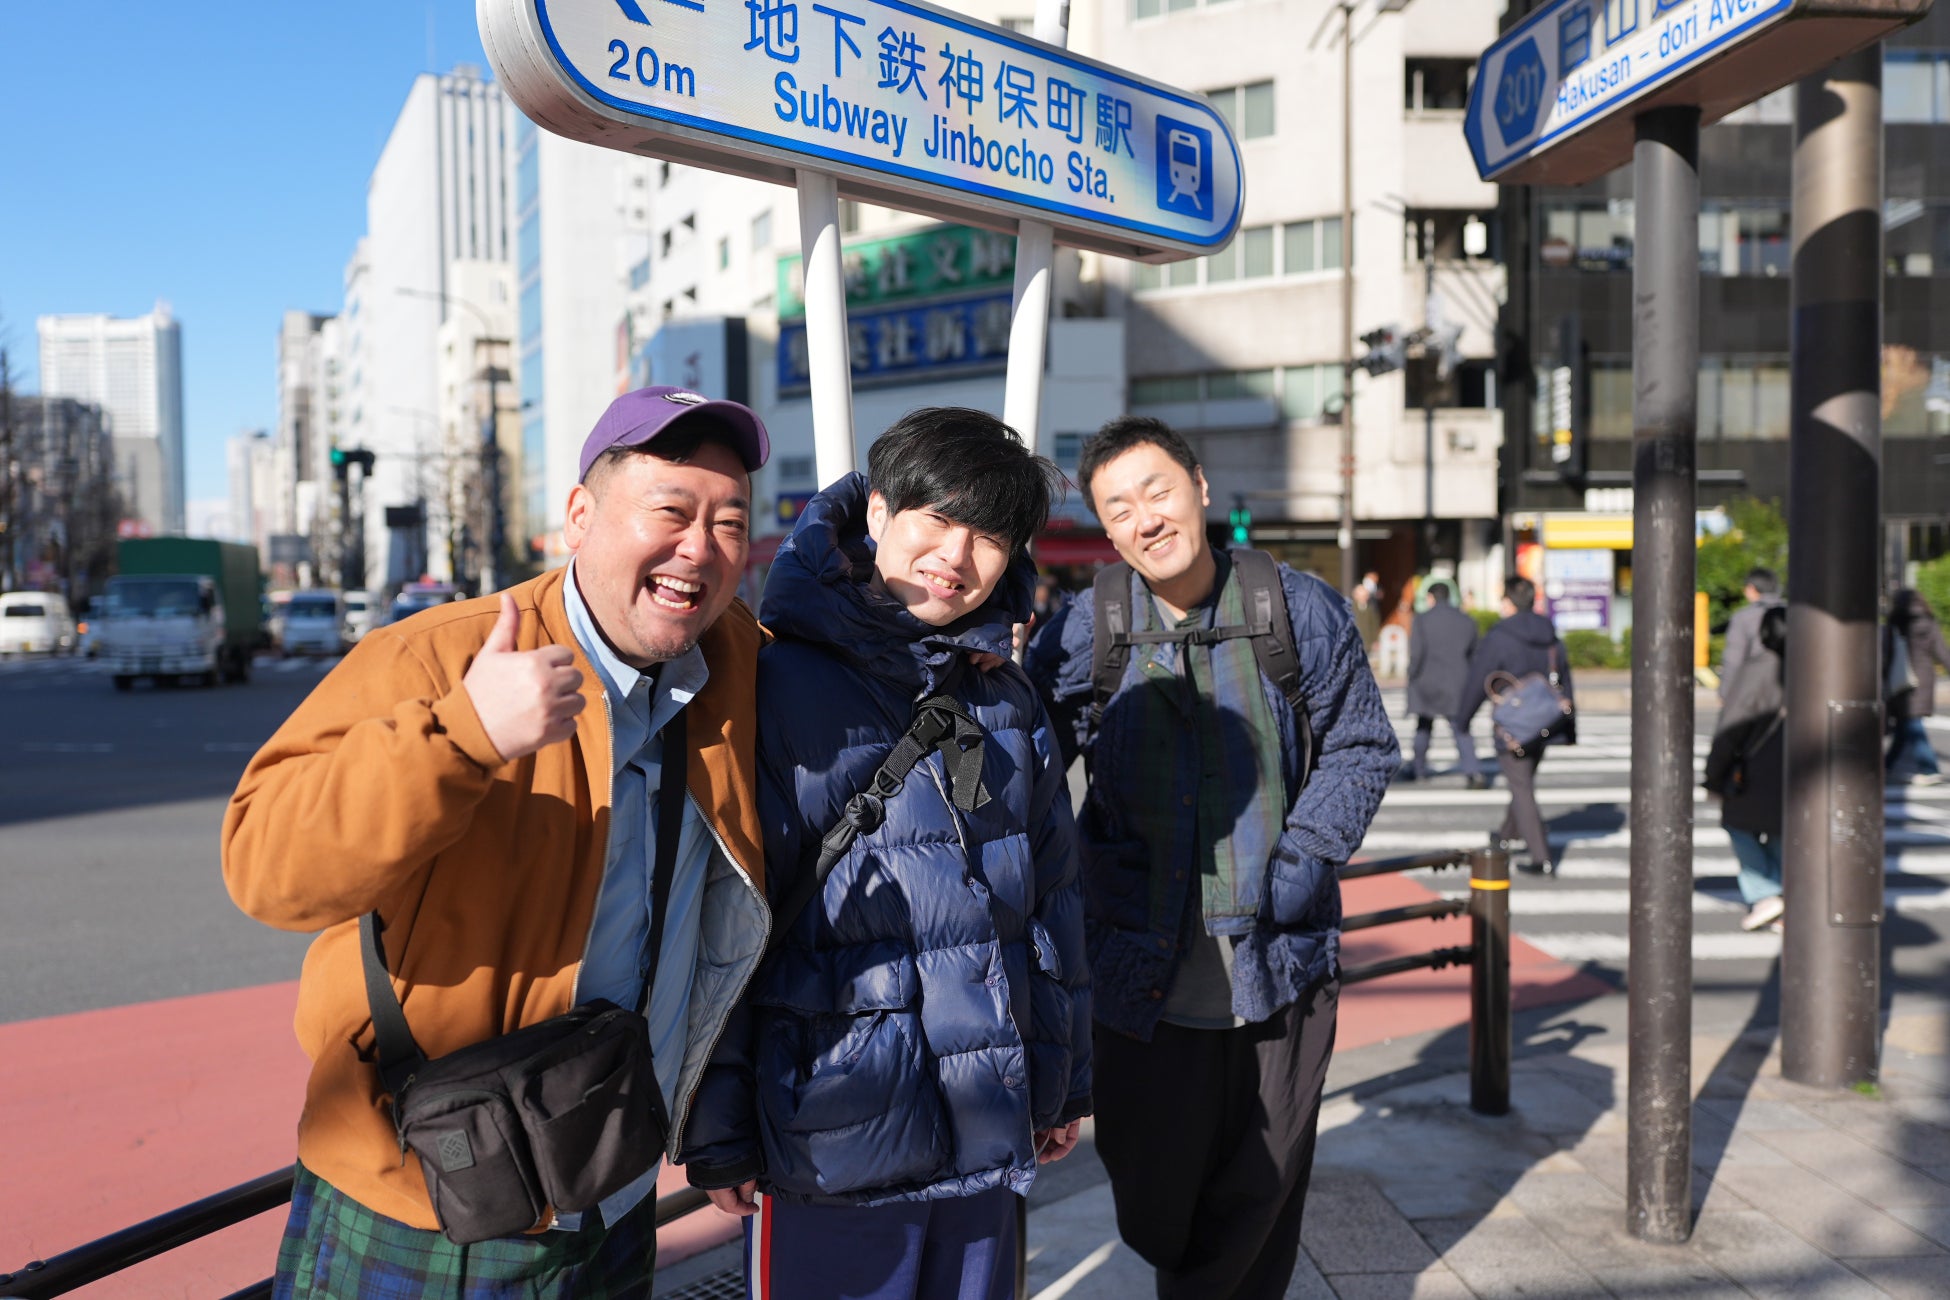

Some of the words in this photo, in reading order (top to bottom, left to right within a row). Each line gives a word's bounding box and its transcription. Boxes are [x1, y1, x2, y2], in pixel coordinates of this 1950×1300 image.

[608, 38, 696, 97] 20m
[744, 0, 1135, 159] 地下鉄神保町駅
[1501, 60, 1540, 126] 301
[1556, 53, 1631, 117] Hakusan
[1659, 6, 1699, 59] dori
[774, 71, 907, 158] Subway
[923, 114, 1054, 185] Jinbocho
[1067, 150, 1115, 203] Sta.
